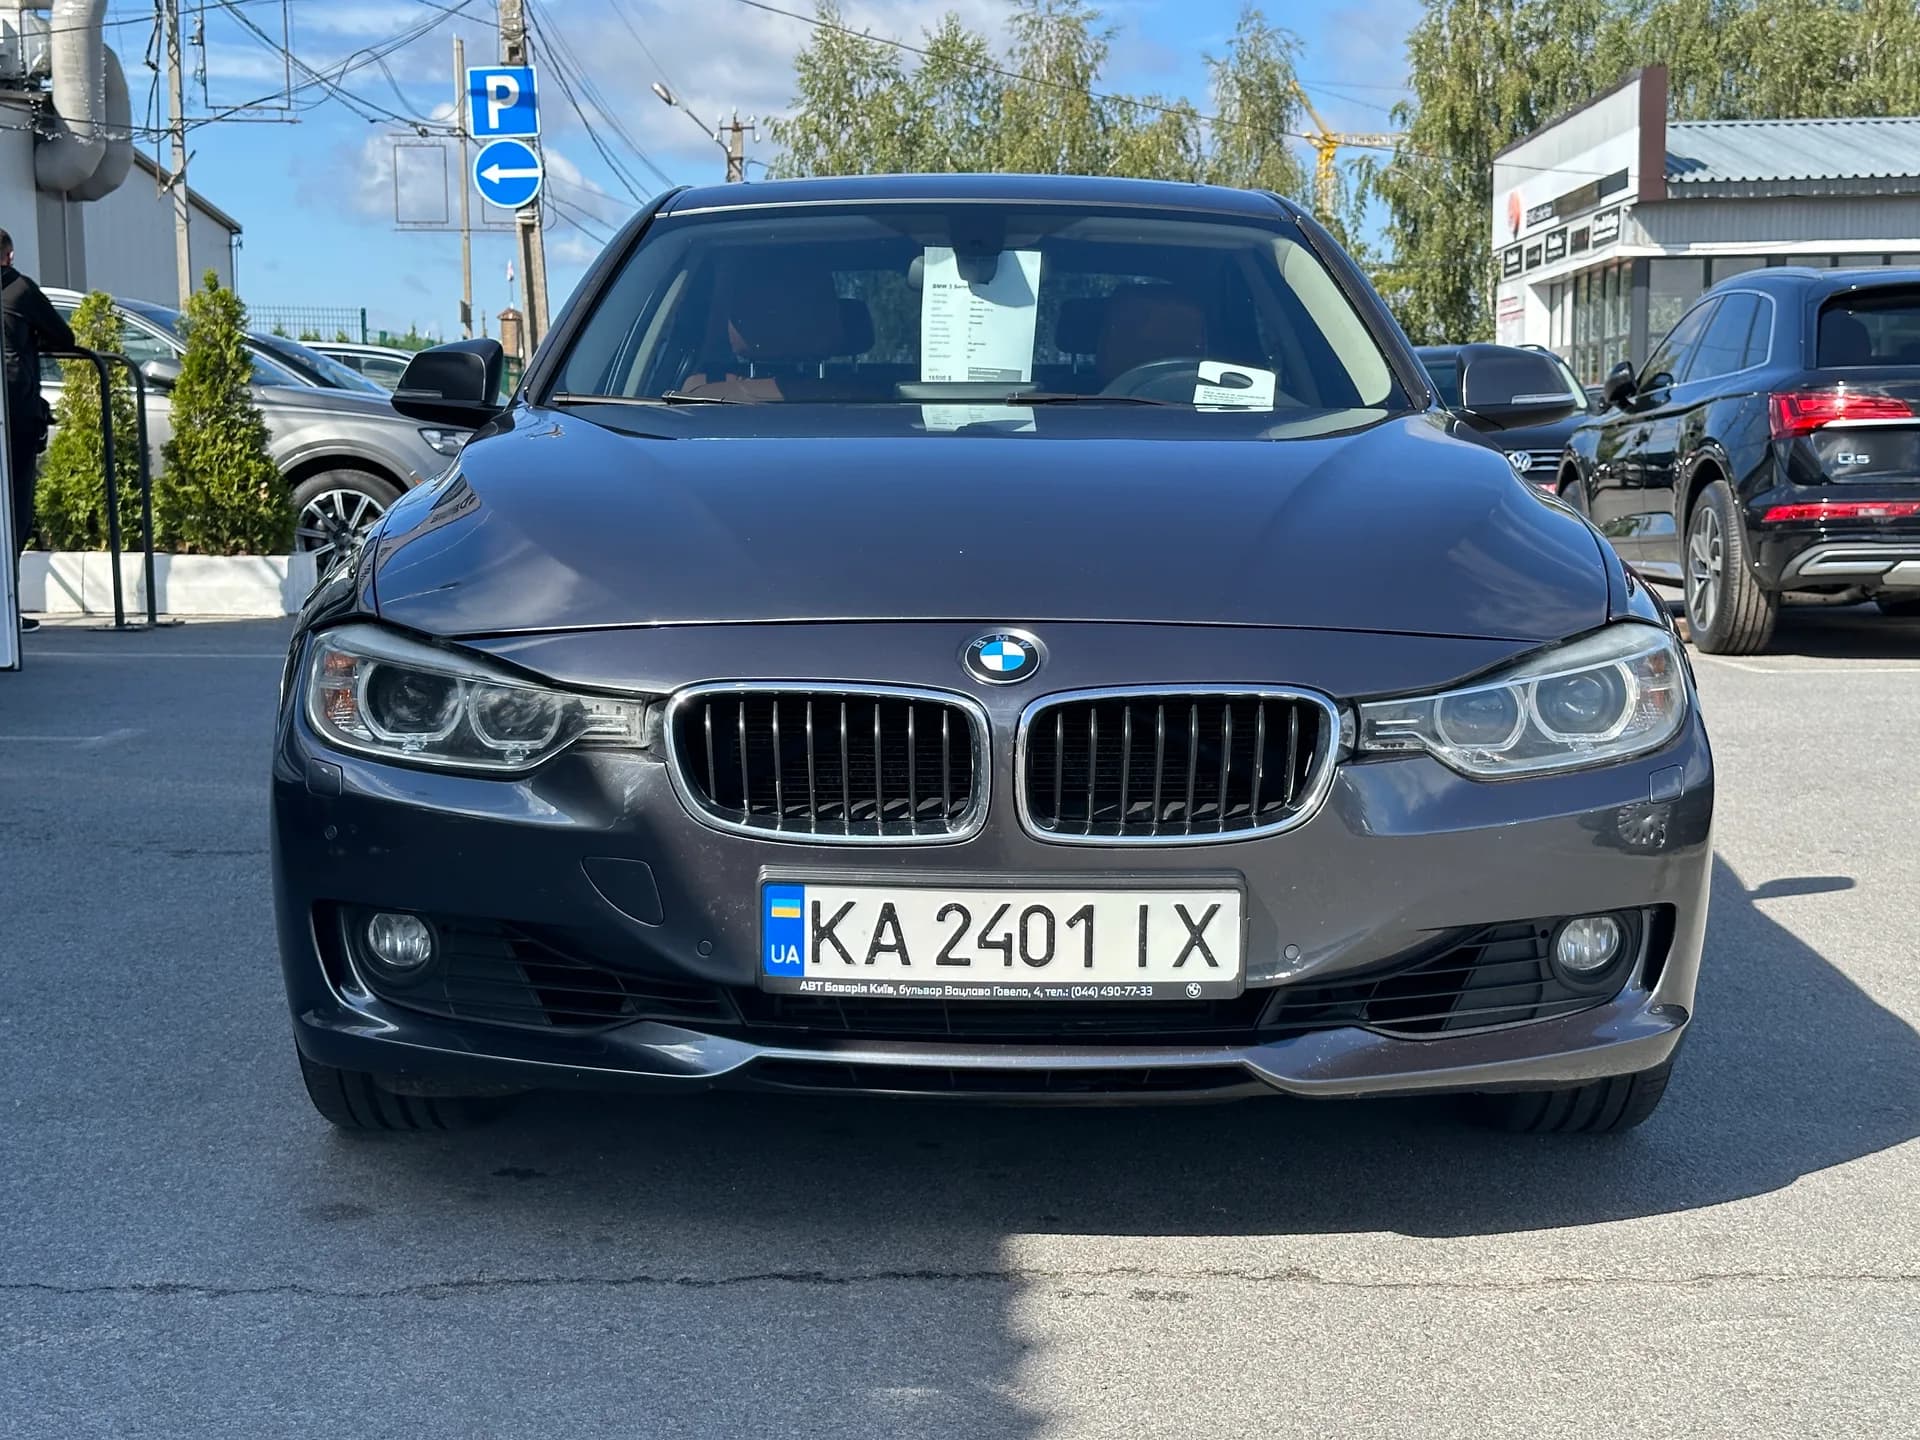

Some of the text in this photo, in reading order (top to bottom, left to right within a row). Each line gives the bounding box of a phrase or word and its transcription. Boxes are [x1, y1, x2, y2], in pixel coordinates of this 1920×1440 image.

[486, 75, 520, 129] P
[1838, 453, 1870, 464] Q5
[973, 635, 1033, 649] BMW
[811, 900, 1221, 968] KA 2401 IX
[771, 944, 801, 964] UA
[800, 980, 1153, 998] АВТ Баварія Київ, бульвар Вацлава Гавела, 4, тел.: (044) 490-77-33
